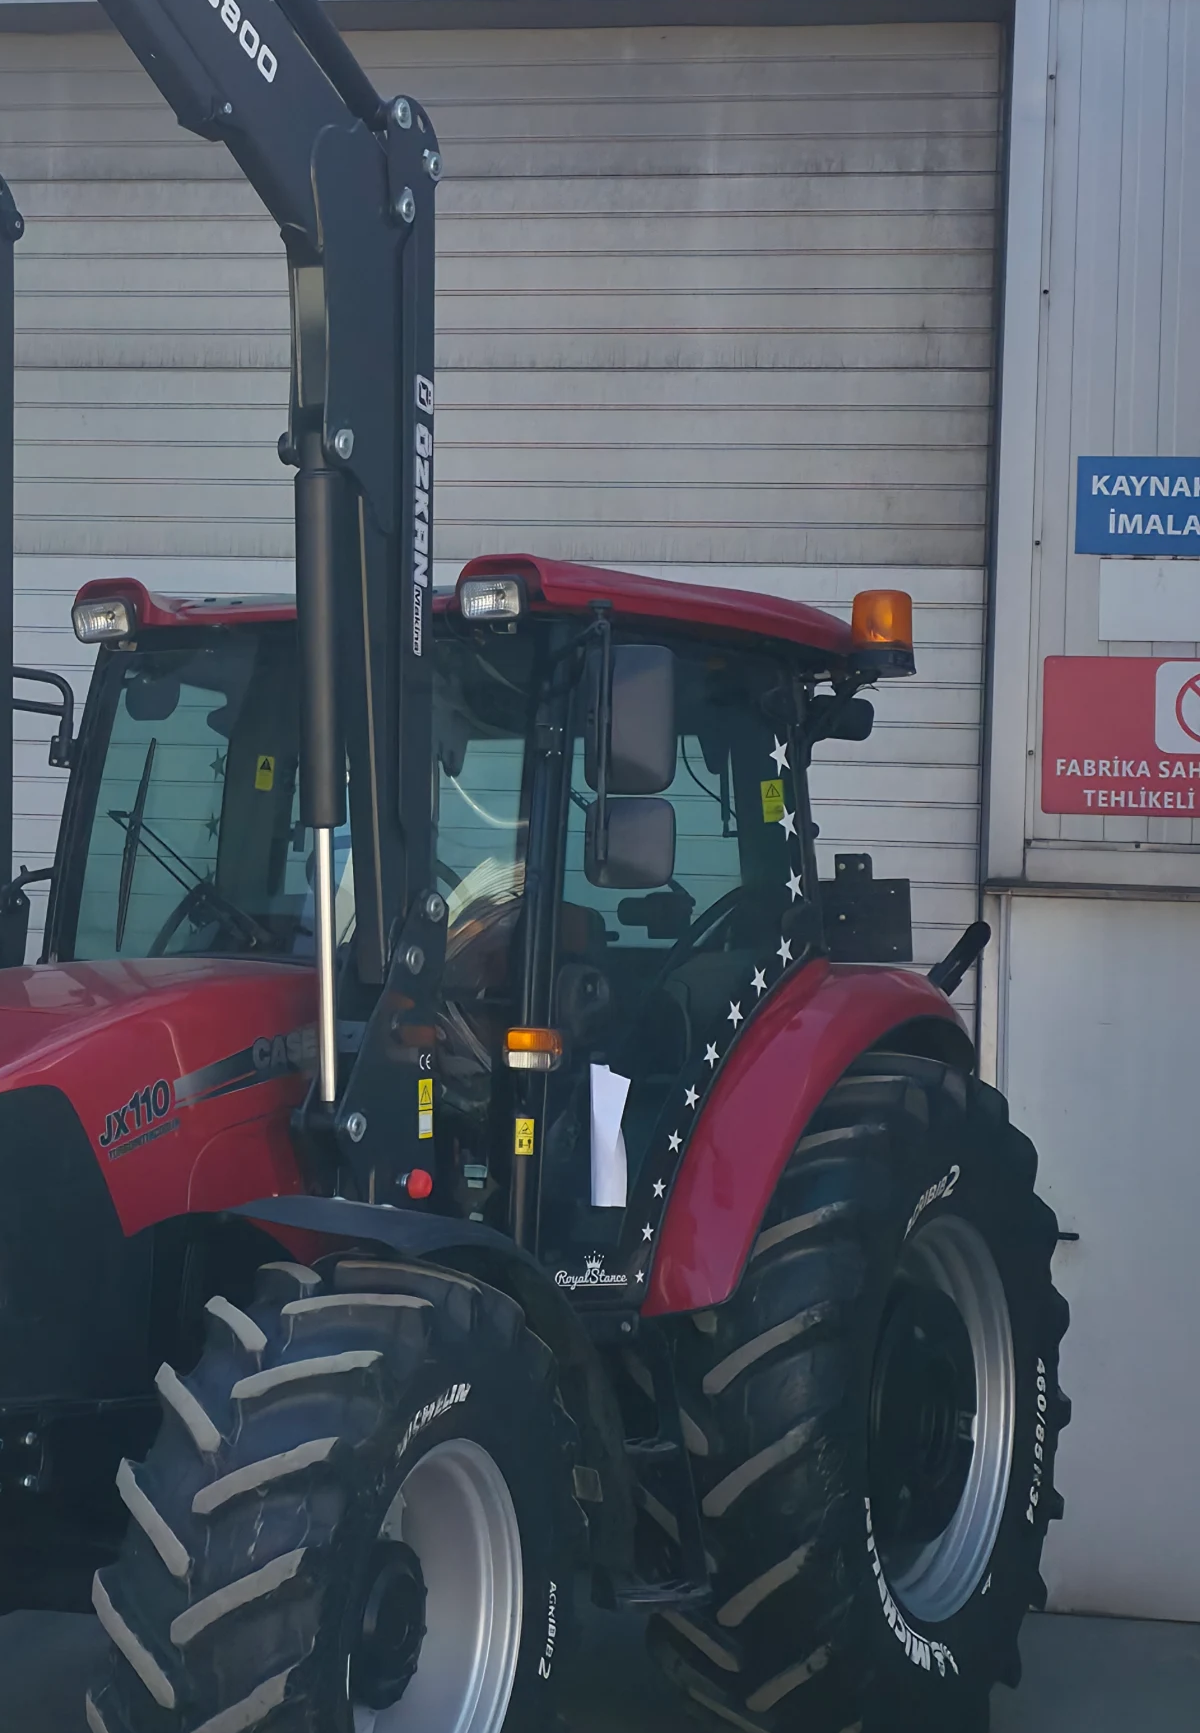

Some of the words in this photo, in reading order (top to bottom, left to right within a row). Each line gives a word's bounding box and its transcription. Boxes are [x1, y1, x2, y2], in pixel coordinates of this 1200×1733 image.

[414, 422, 433, 588] ÖZKAN
[1056, 756, 1151, 778] FABRİKA
[1083, 787, 1195, 809] TEHLİKELİ
[99, 1079, 171, 1147] JX110
[941, 1164, 960, 1198] 2
